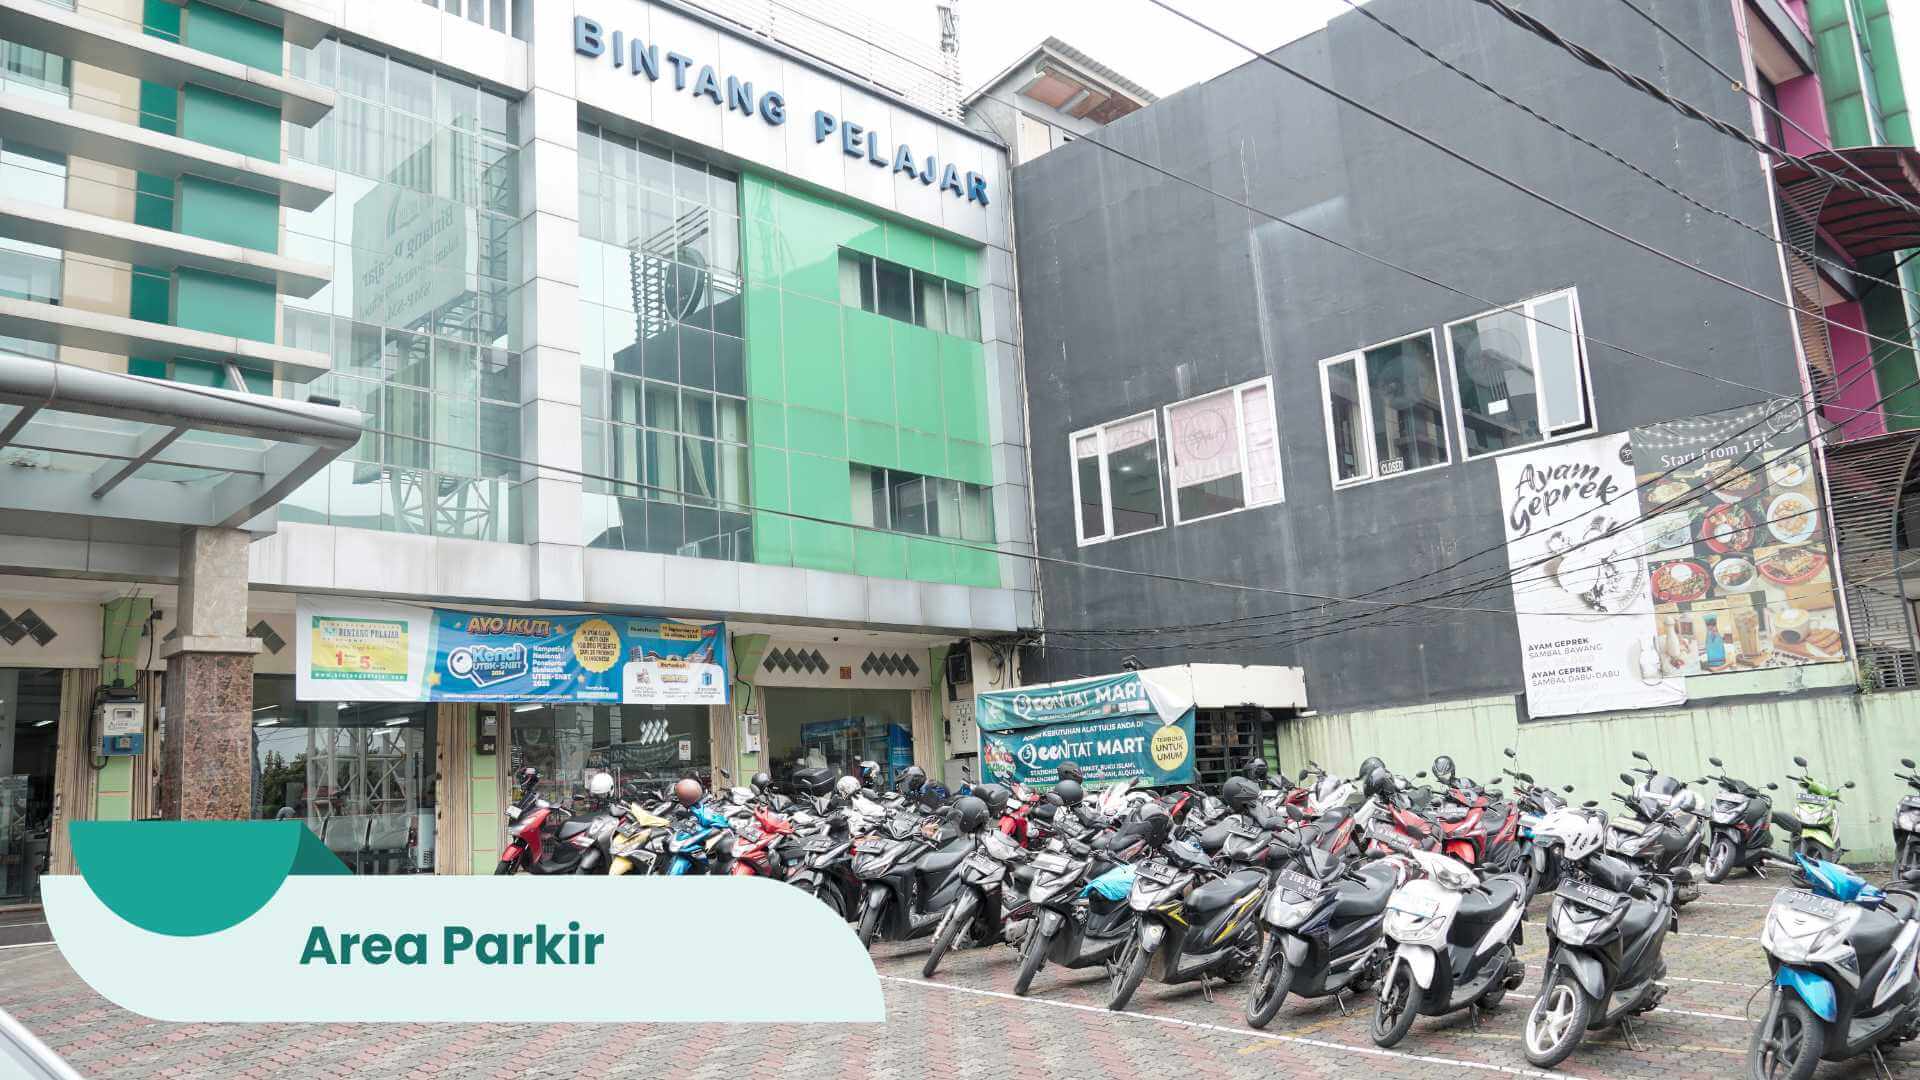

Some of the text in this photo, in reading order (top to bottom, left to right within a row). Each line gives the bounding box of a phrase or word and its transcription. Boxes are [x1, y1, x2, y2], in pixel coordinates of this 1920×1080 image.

[574, 15, 991, 207] BINTANG PELAJAR
[1660, 451, 1695, 468] Start
[1701, 445, 1739, 460] From
[1515, 463, 1600, 496] Ayam
[1510, 474, 1619, 536] Geprek
[467, 616, 504, 635] AYO
[1528, 637, 1590, 652] AYAM GEPREK
[1564, 643, 1603, 655] BAWANG
[1531, 665, 1593, 679] AYAM GEPREK
[1532, 671, 1620, 687] SAMBAL DABU-DABU
[1094, 681, 1146, 703] MART
[1042, 725, 1081, 737] KEBUTUHAN
[1081, 725, 1097, 733] ALAT
[1098, 723, 1116, 731] TULIS
[1116, 722, 1136, 730] ANDA
[1097, 736, 1145, 756] MART
[1155, 743, 1183, 752] UNTUK
[1157, 751, 1183, 761] UMUM
[1118, 767, 1145, 776] ALQURAN
